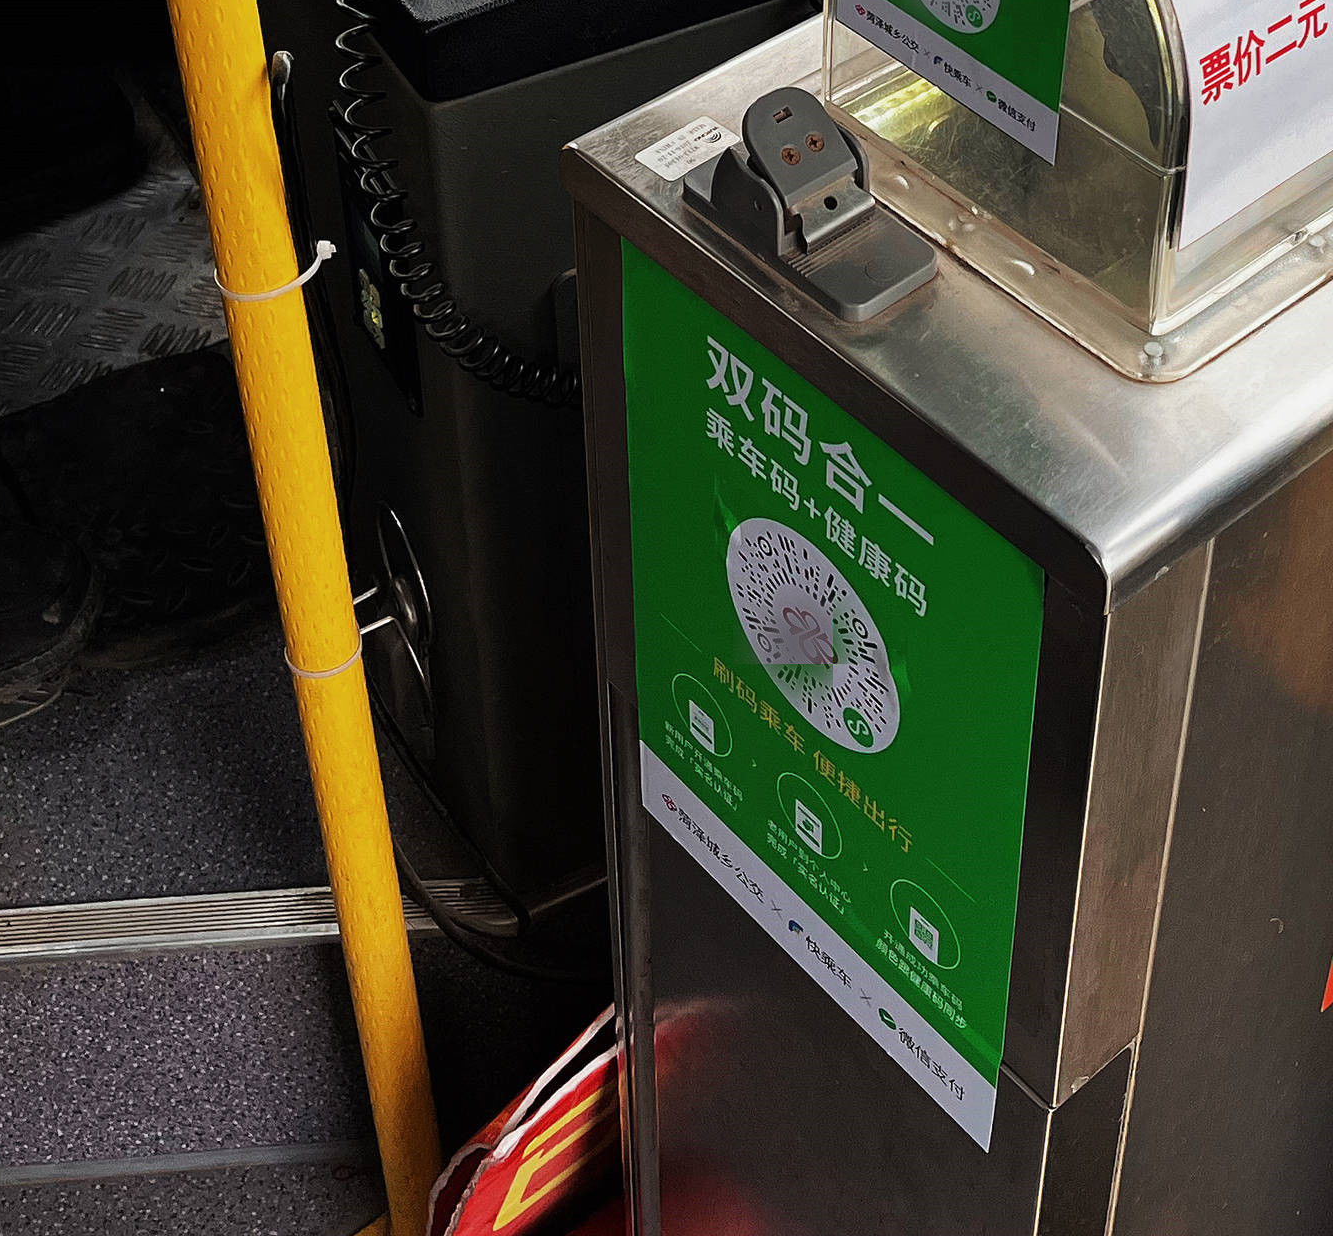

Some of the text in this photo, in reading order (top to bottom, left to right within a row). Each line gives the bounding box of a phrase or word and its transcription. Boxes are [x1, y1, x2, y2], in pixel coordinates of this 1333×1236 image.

[865, 9, 1037, 133] 菏泽城乡公交 快乘车 微信支付
[705, 335, 935, 547] 双码合一
[705, 407, 929, 618] 乘车码+健康码
[712, 656, 915, 854] 刷码乘车 便捷出行
[676, 807, 966, 1102] 菏泽城乡公交 快乘车 微信支付
